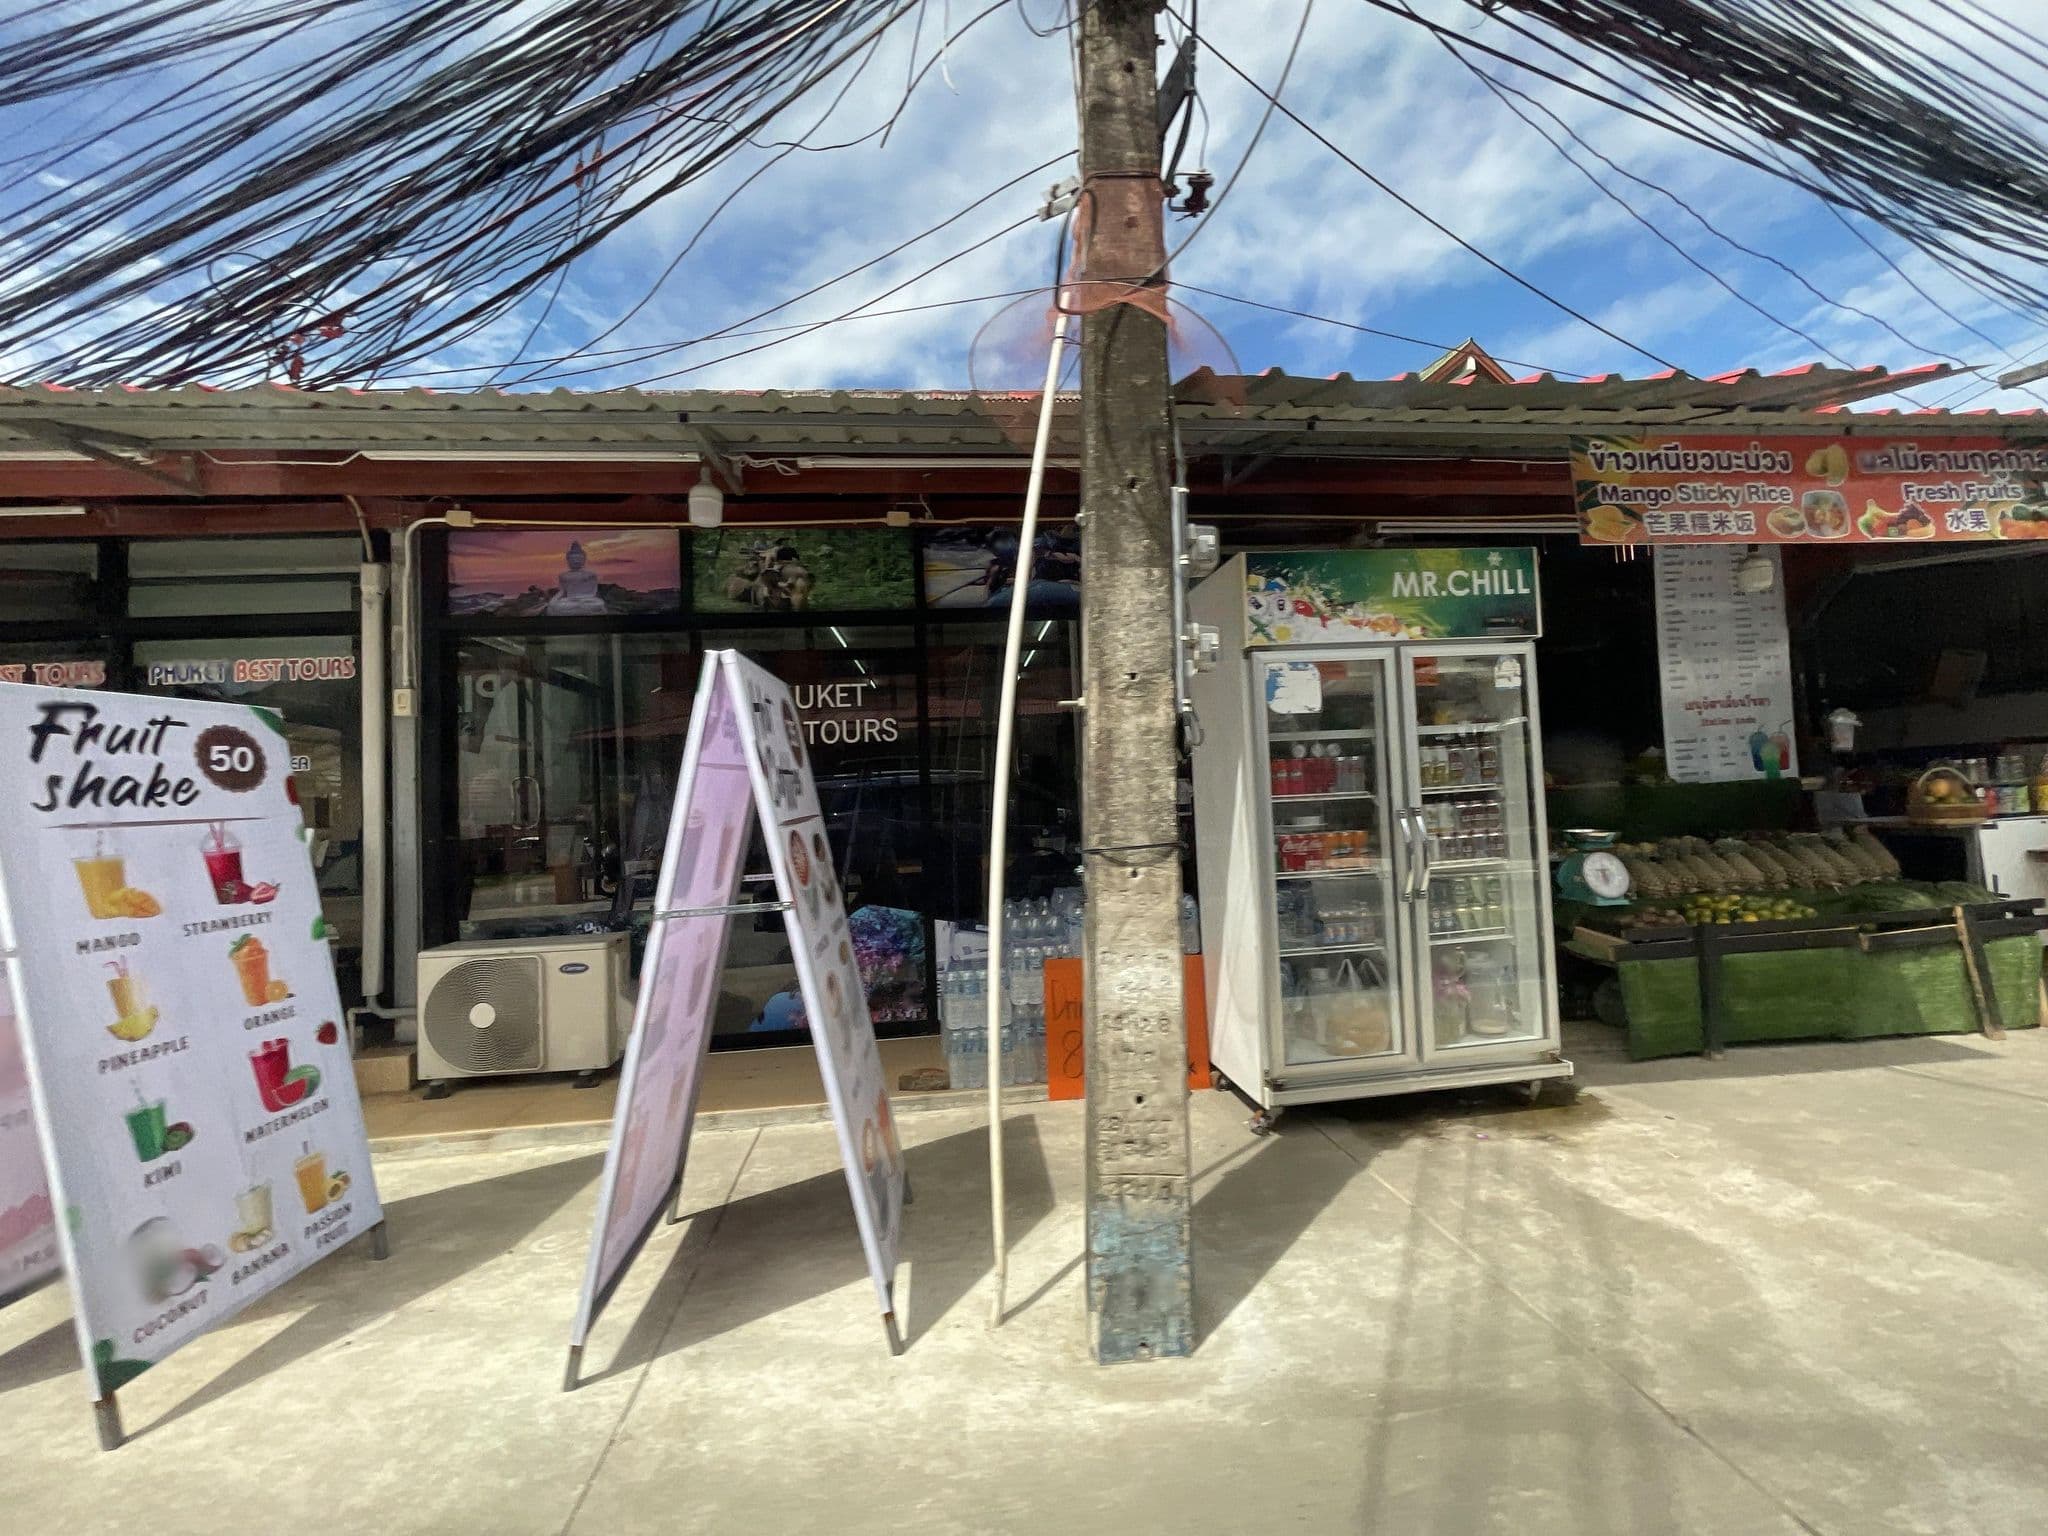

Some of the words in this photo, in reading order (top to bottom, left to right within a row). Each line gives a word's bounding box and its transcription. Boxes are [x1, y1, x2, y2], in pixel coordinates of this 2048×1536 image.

[1599, 484, 1672, 508] Mango
[1677, 483, 1743, 506] Sticky
[1746, 483, 1792, 502] Rice
[1902, 482, 1960, 501] Fresh
[1965, 480, 2023, 500] Fruits
[1946, 509, 1989, 532] 水果
[1391, 568, 1531, 598] MR.CHILL
[233, 658, 285, 683] BEST
[287, 655, 357, 680] TOURS
[28, 701, 190, 763] Fruit
[802, 717, 899, 745] TOURS
[208, 744, 256, 774] 50
[31, 761, 201, 812] shake
[75, 931, 142, 955] MANGO
